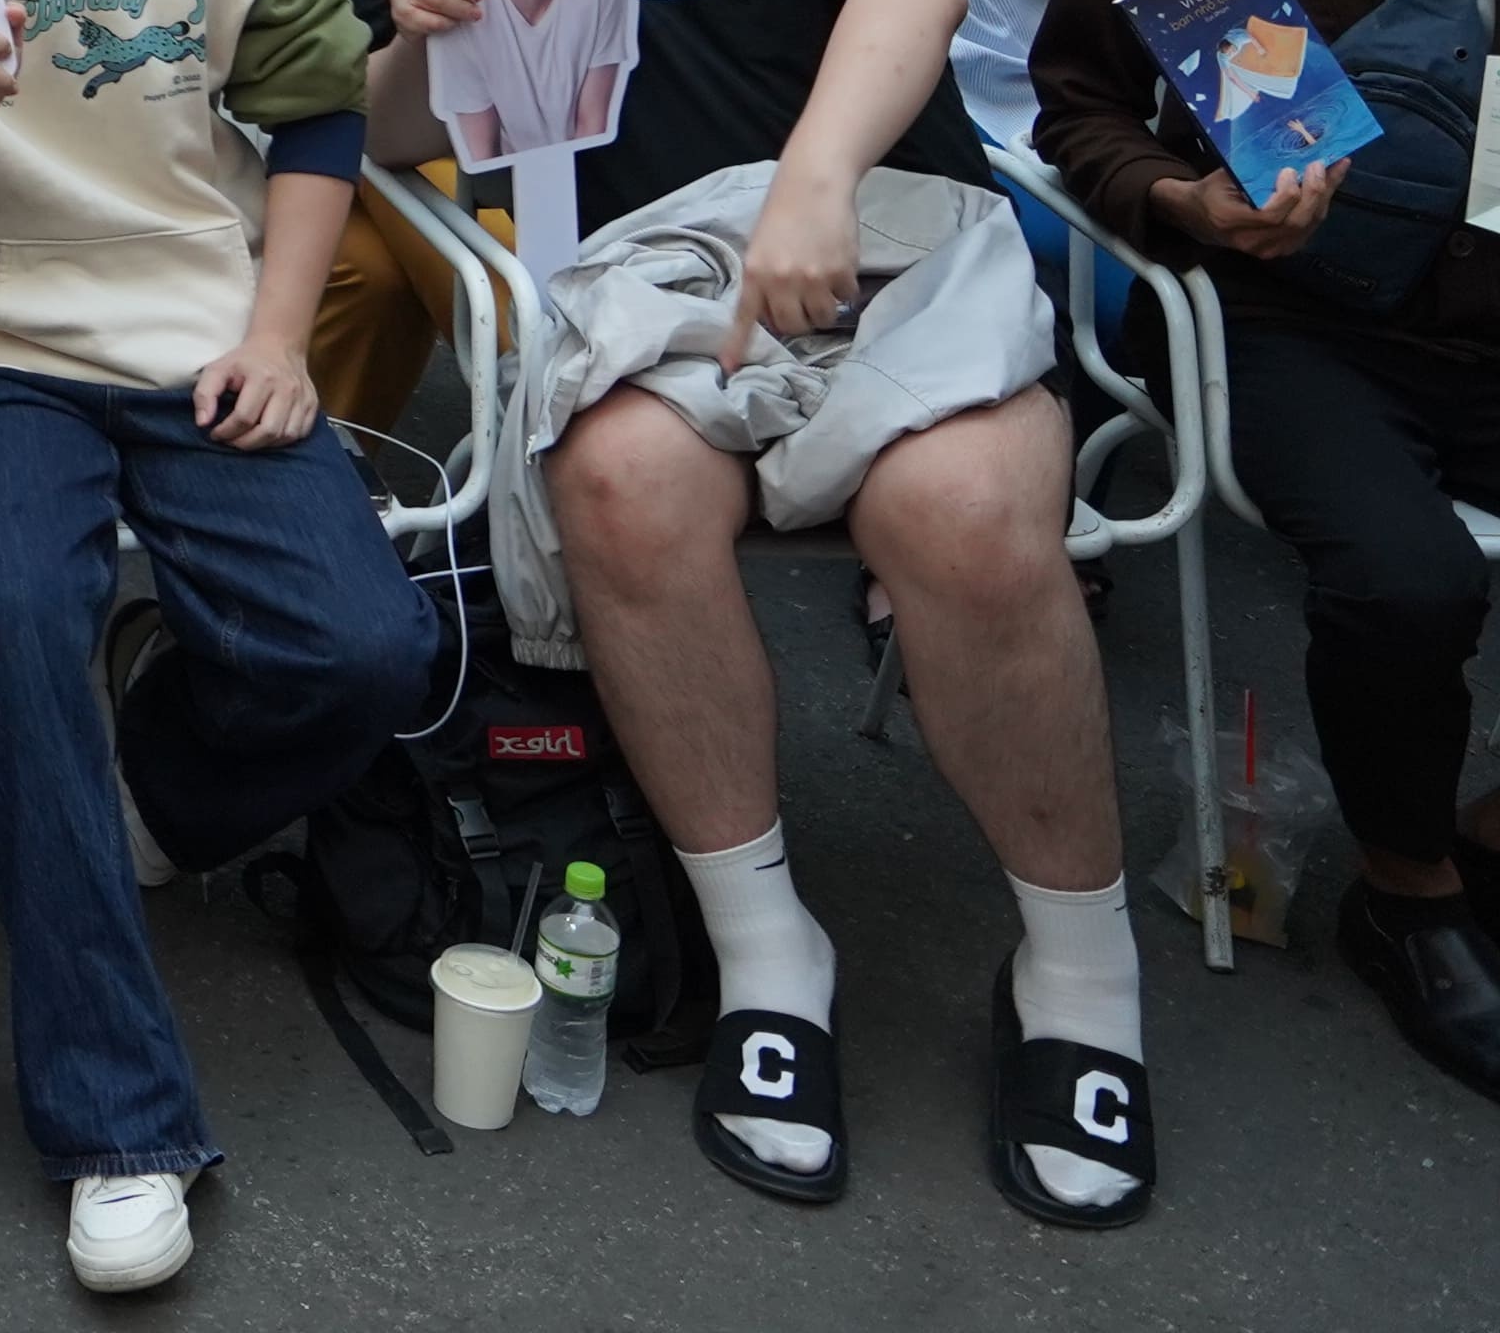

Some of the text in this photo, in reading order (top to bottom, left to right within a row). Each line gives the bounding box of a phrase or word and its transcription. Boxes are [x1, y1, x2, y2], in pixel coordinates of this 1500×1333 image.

[1170, 14, 1195, 31] bạn
[495, 729, 581, 756] x-girl
[740, 1032, 794, 1098] C
[1073, 1070, 1129, 1144] C
